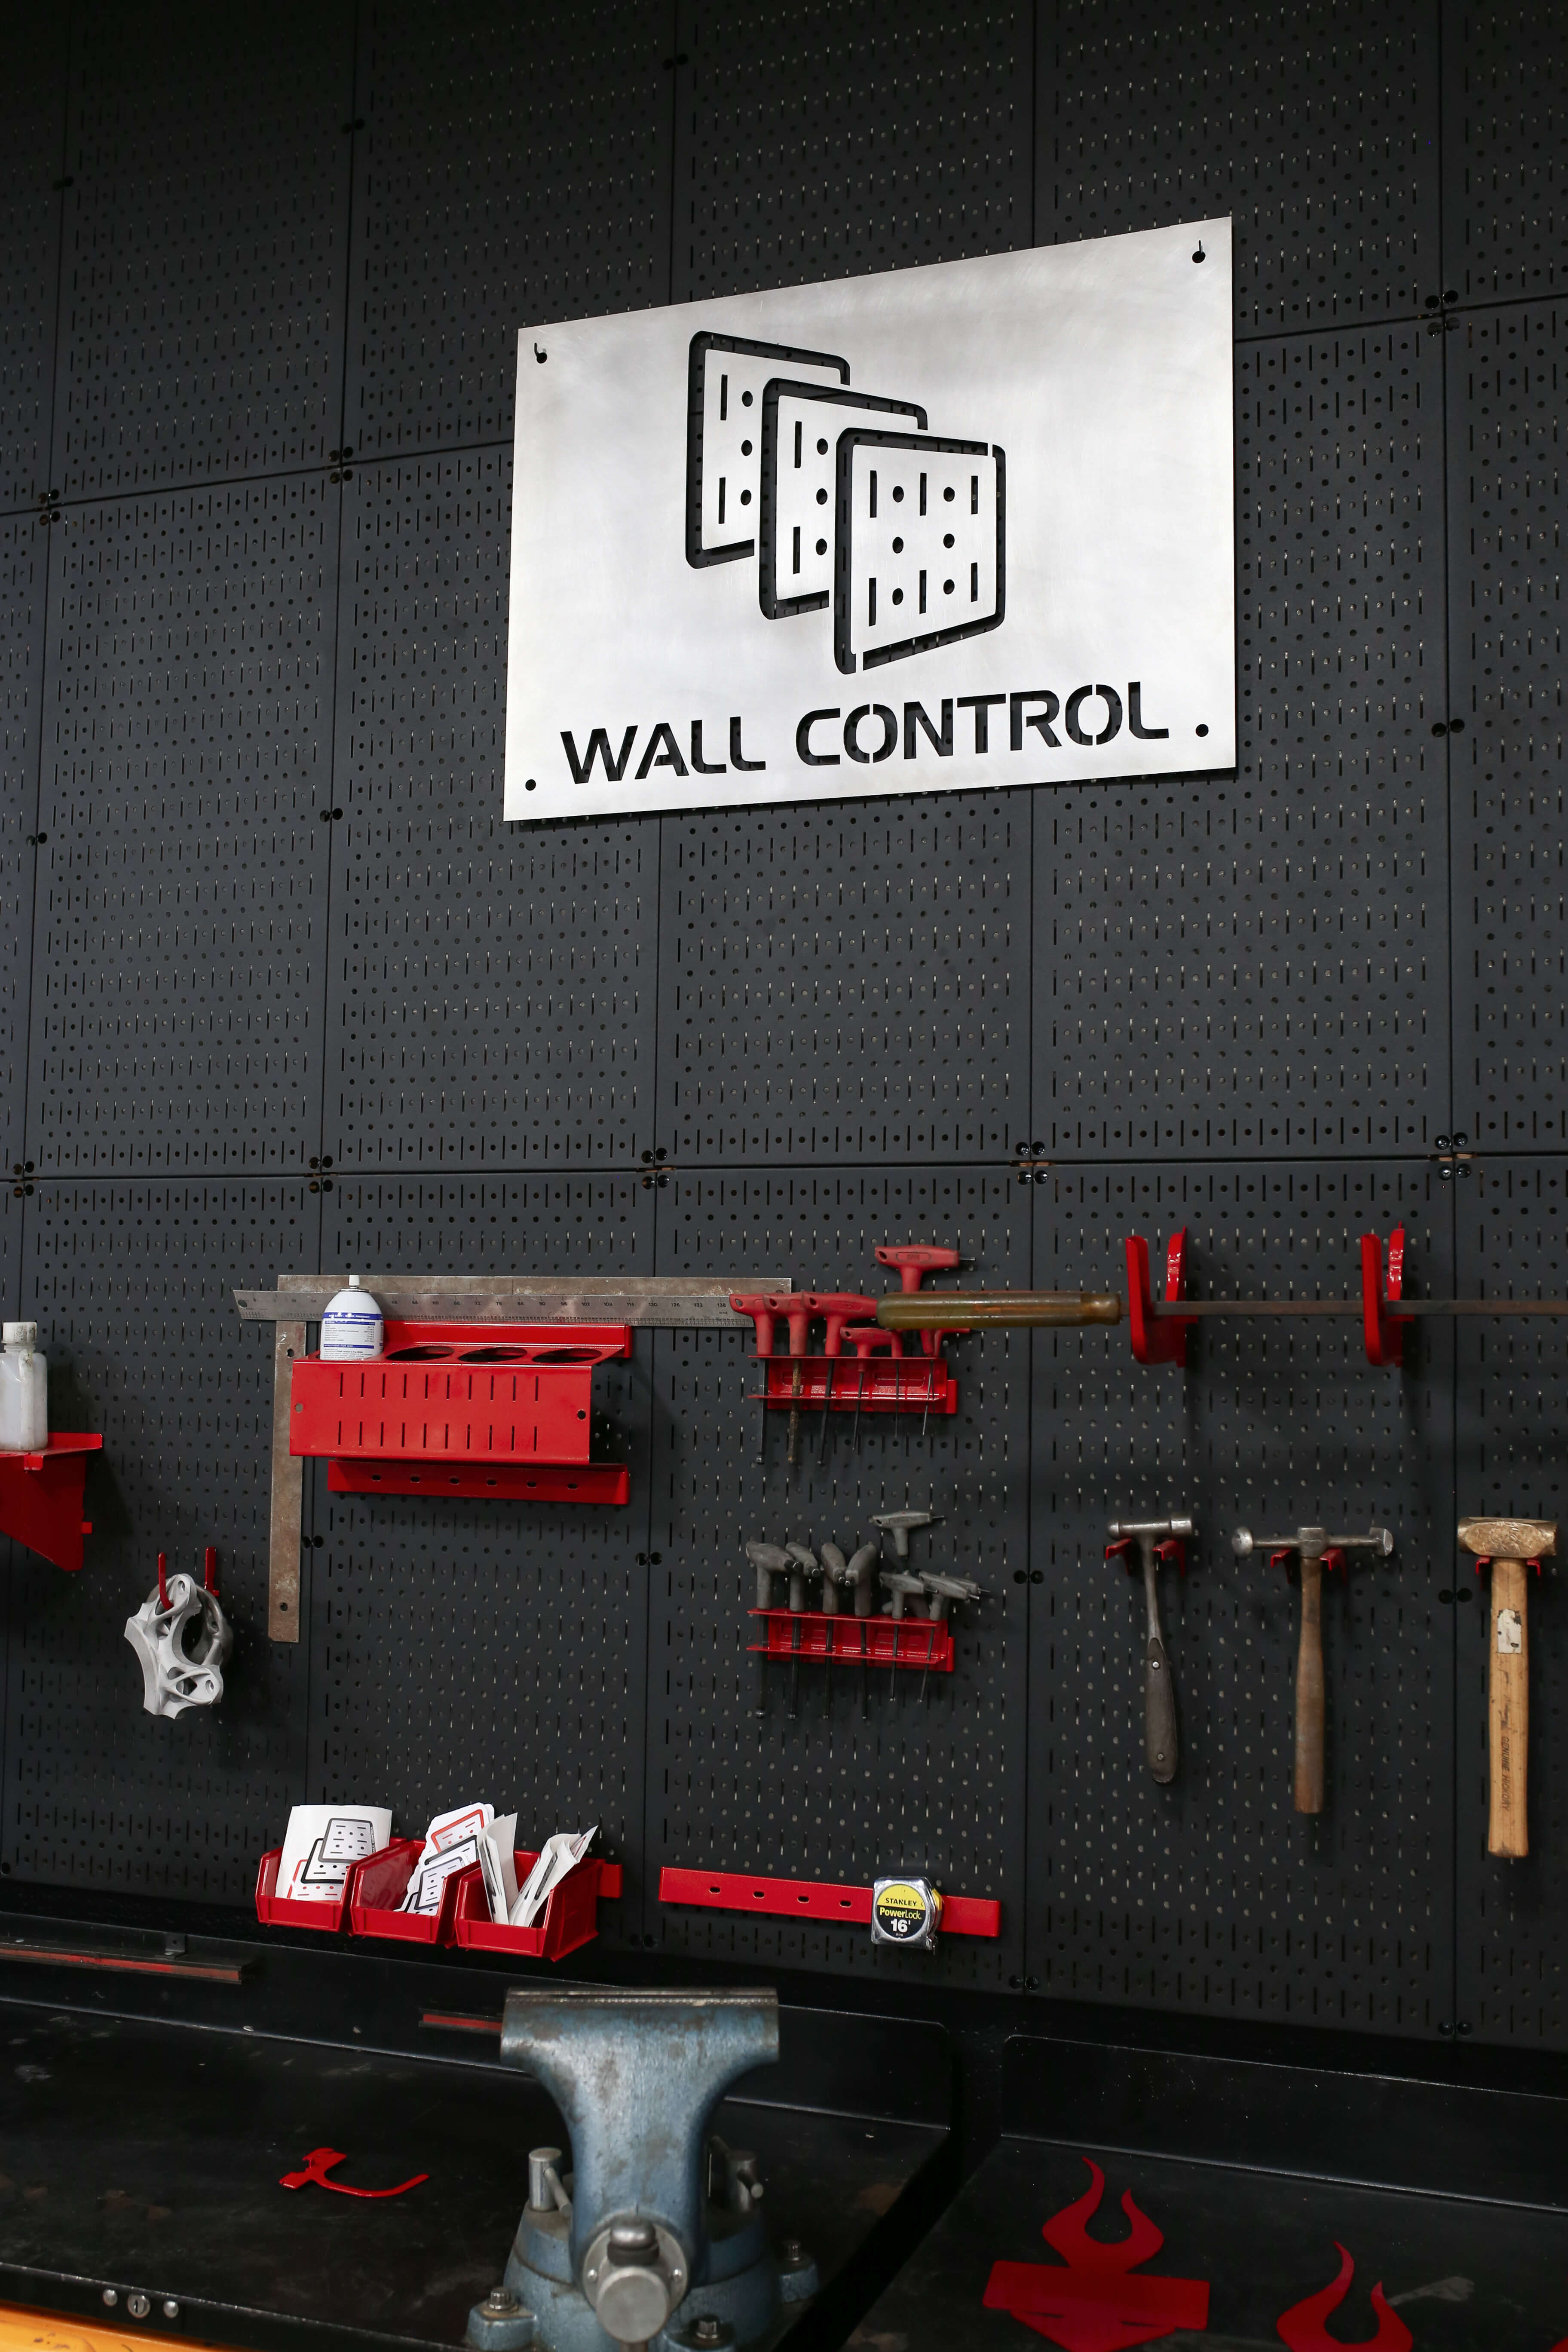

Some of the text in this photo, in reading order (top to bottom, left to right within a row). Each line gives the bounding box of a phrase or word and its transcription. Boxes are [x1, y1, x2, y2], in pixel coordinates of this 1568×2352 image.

[560, 681, 1169, 784] WALL CONTROL
[885, 1898, 917, 1906] STANLEY
[880, 1907, 921, 1920] PowerLock
